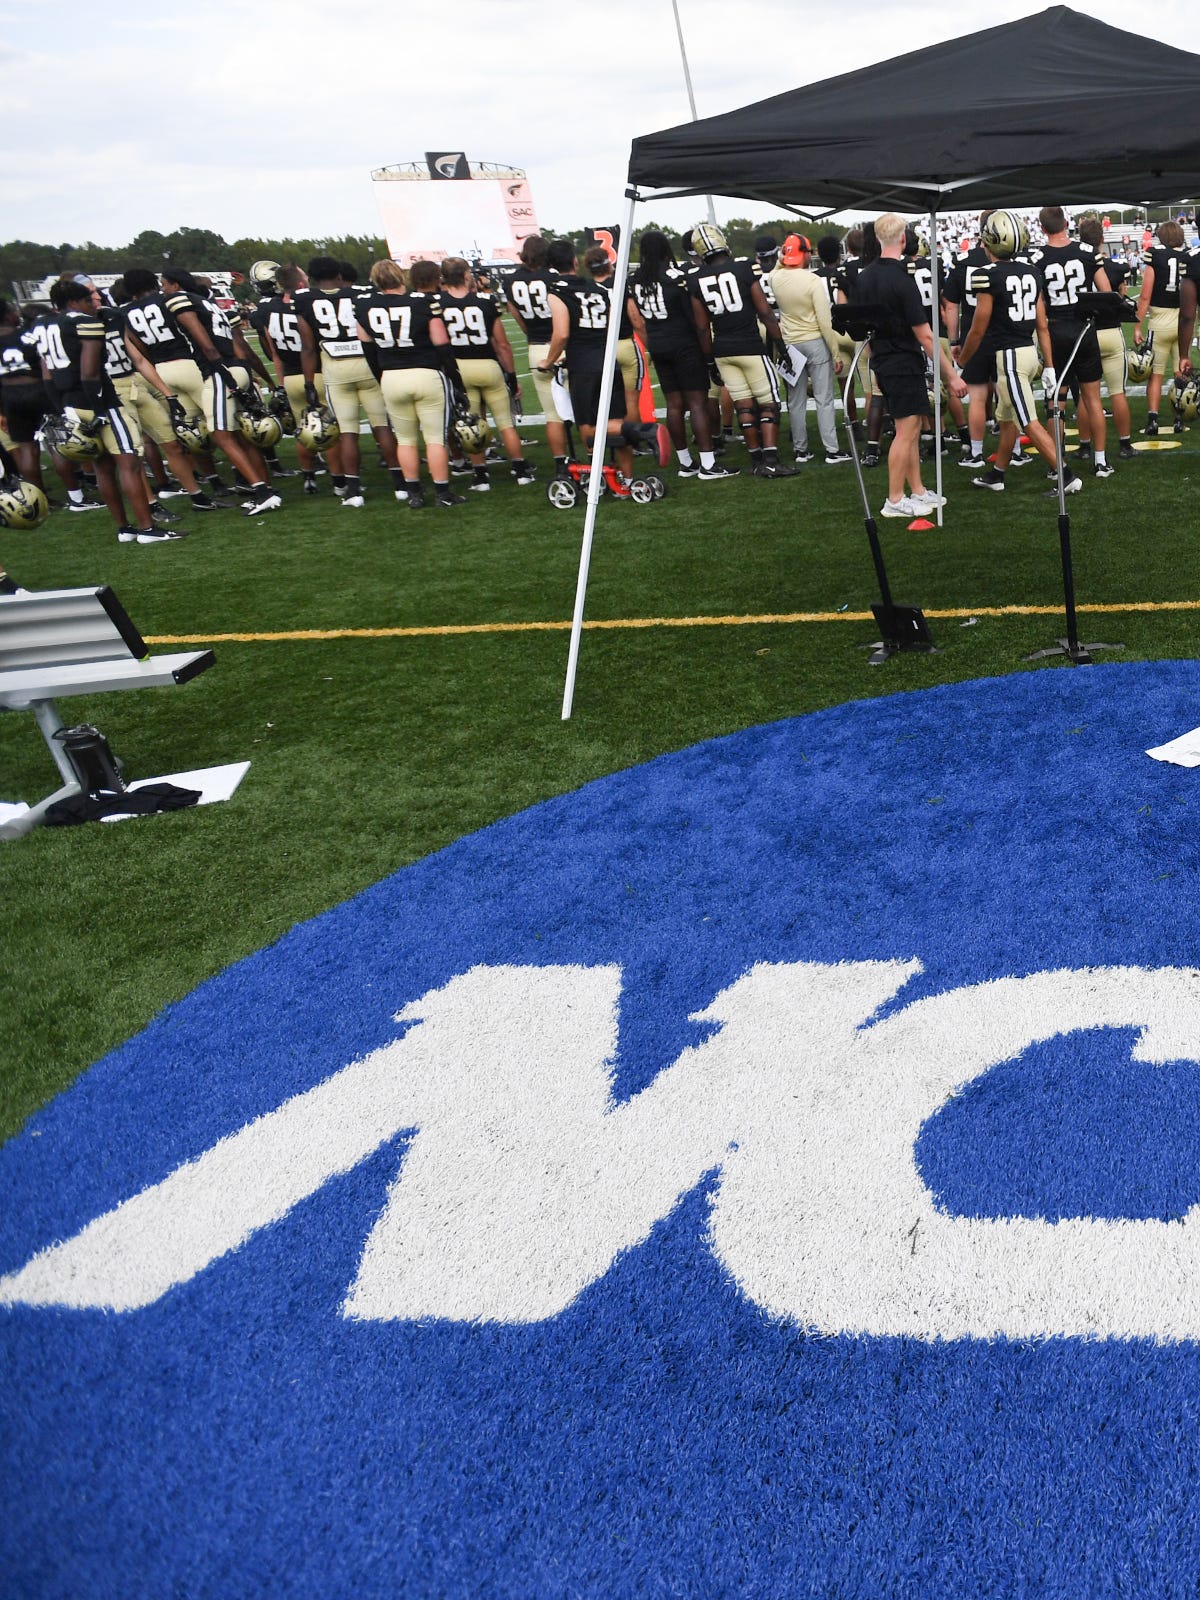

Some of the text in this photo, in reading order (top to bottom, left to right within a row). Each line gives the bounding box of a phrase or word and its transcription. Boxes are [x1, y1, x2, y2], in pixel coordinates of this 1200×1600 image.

[511, 207, 533, 217] SAC
[593, 230, 617, 265] 3
[511, 280, 551, 319] 93
[698, 271, 743, 315] 50
[1005, 274, 1037, 322] 32
[1044, 258, 1088, 306] 22
[127, 304, 175, 346] 92
[312, 298, 357, 338] 94
[368, 306, 414, 348] 97
[443, 306, 488, 346] 29
[574, 291, 607, 329] 12
[36, 323, 71, 370] 20
[267, 312, 302, 351] 45
